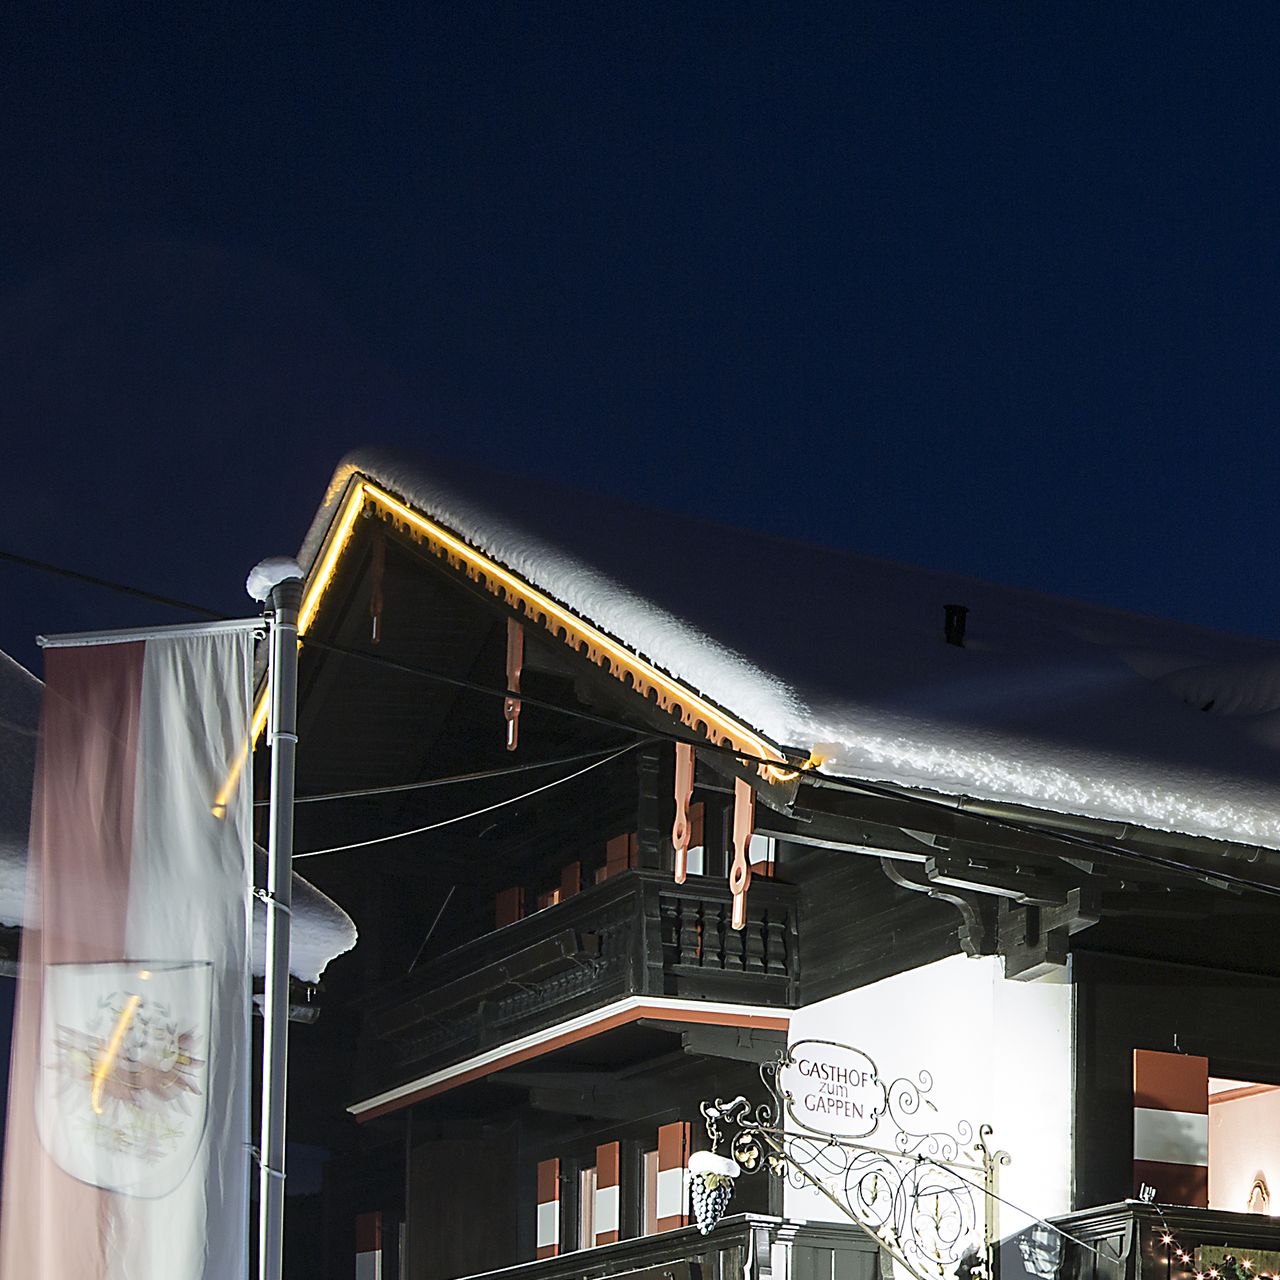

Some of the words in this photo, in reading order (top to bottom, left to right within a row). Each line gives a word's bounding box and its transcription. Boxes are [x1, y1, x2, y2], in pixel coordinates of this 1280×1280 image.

[798, 1059, 868, 1088] GASTHOF
[819, 1081, 848, 1098] zum
[804, 1094, 864, 1119] GAPPEN
